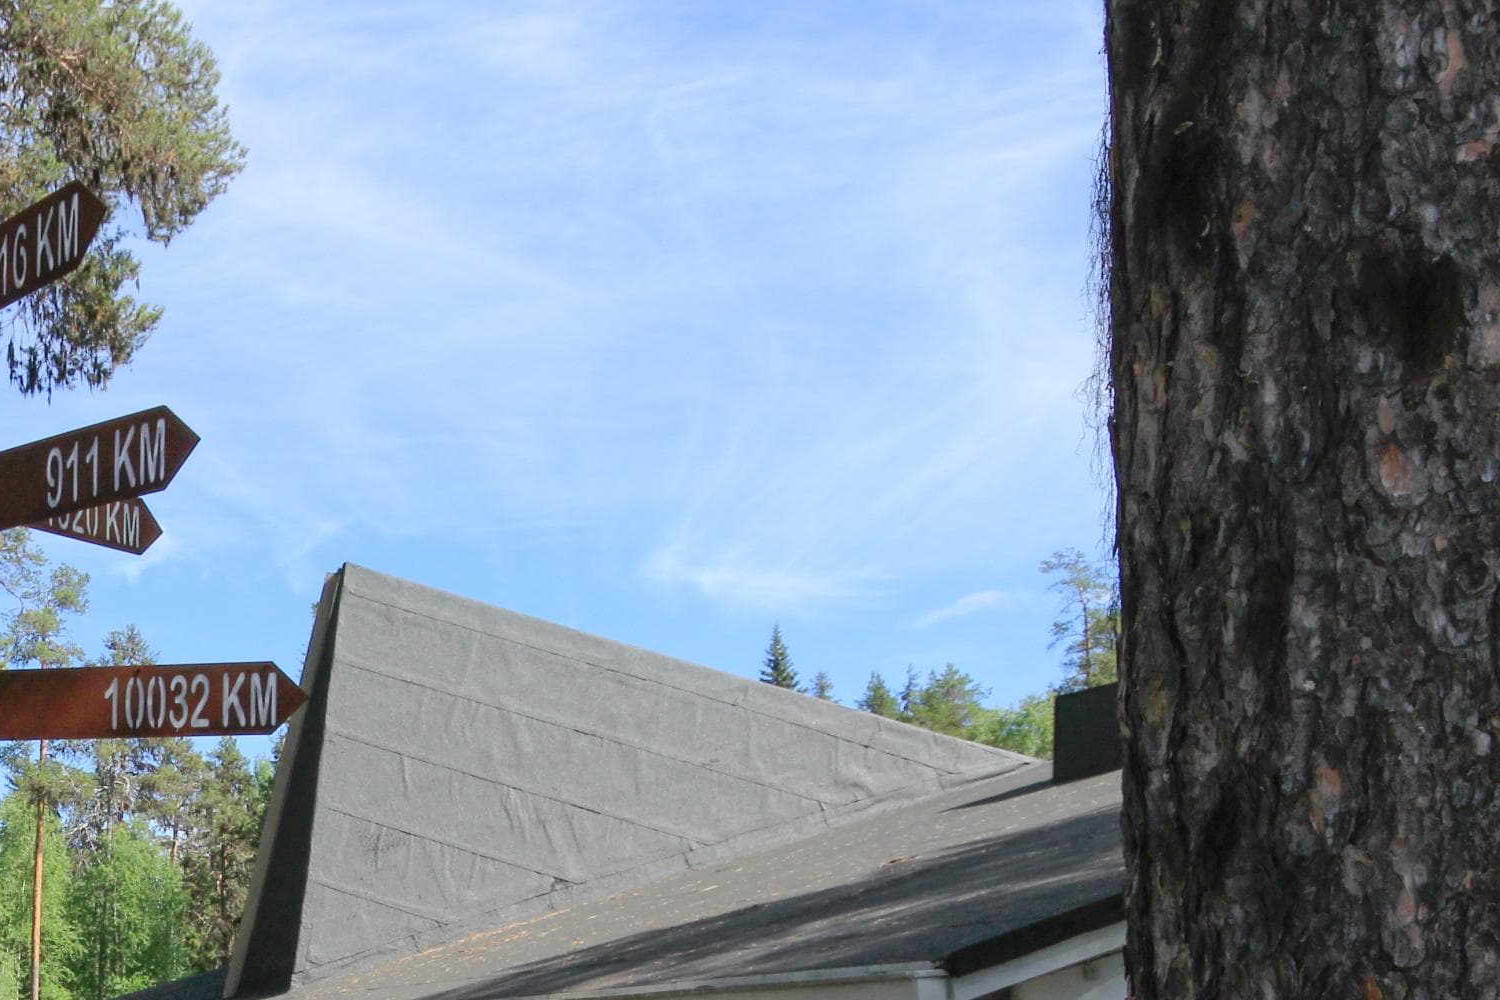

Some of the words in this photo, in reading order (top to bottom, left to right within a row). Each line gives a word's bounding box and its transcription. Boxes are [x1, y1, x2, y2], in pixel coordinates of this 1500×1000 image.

[36, 191, 80, 279] KM
[46, 436, 100, 508] 911
[114, 417, 167, 492] KM
[106, 501, 141, 549] KM
[103, 672, 210, 730] 10032
[221, 671, 277, 727] KM
